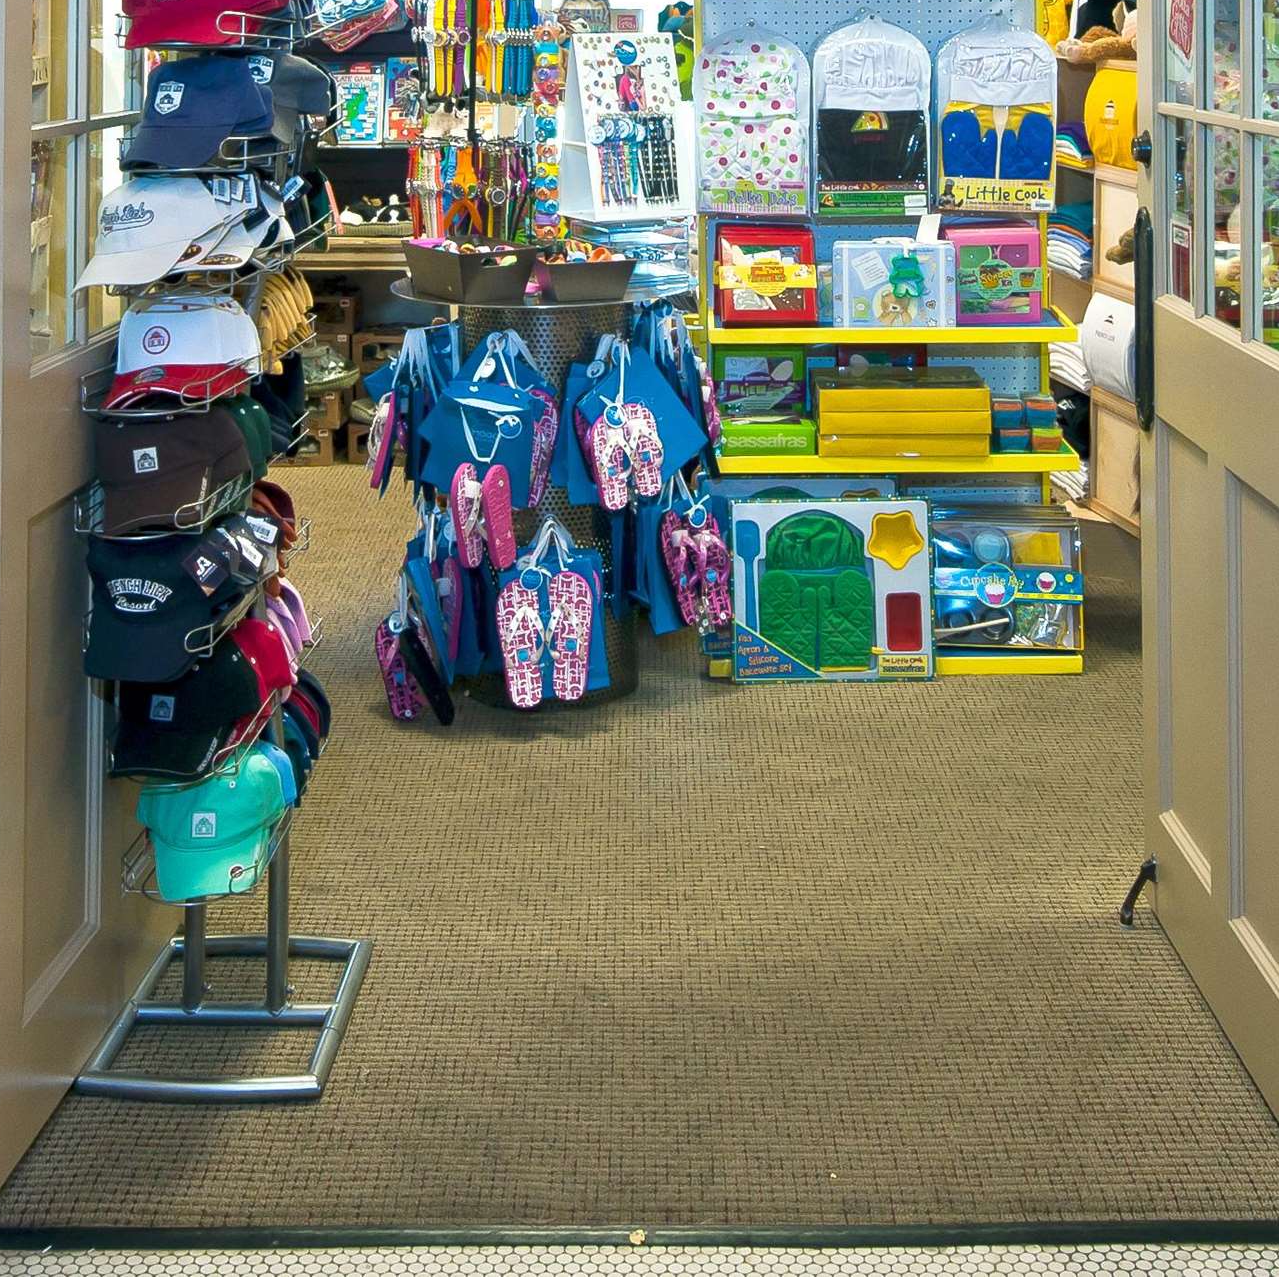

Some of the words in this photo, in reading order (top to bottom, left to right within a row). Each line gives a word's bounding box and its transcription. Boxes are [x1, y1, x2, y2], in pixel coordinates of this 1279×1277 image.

[966, 185, 1010, 202] Little
[1014, 187, 1046, 202] Cook
[727, 433, 808, 448] sassafras
[142, 580, 173, 603] LICK
[115, 595, 157, 610] Resort
